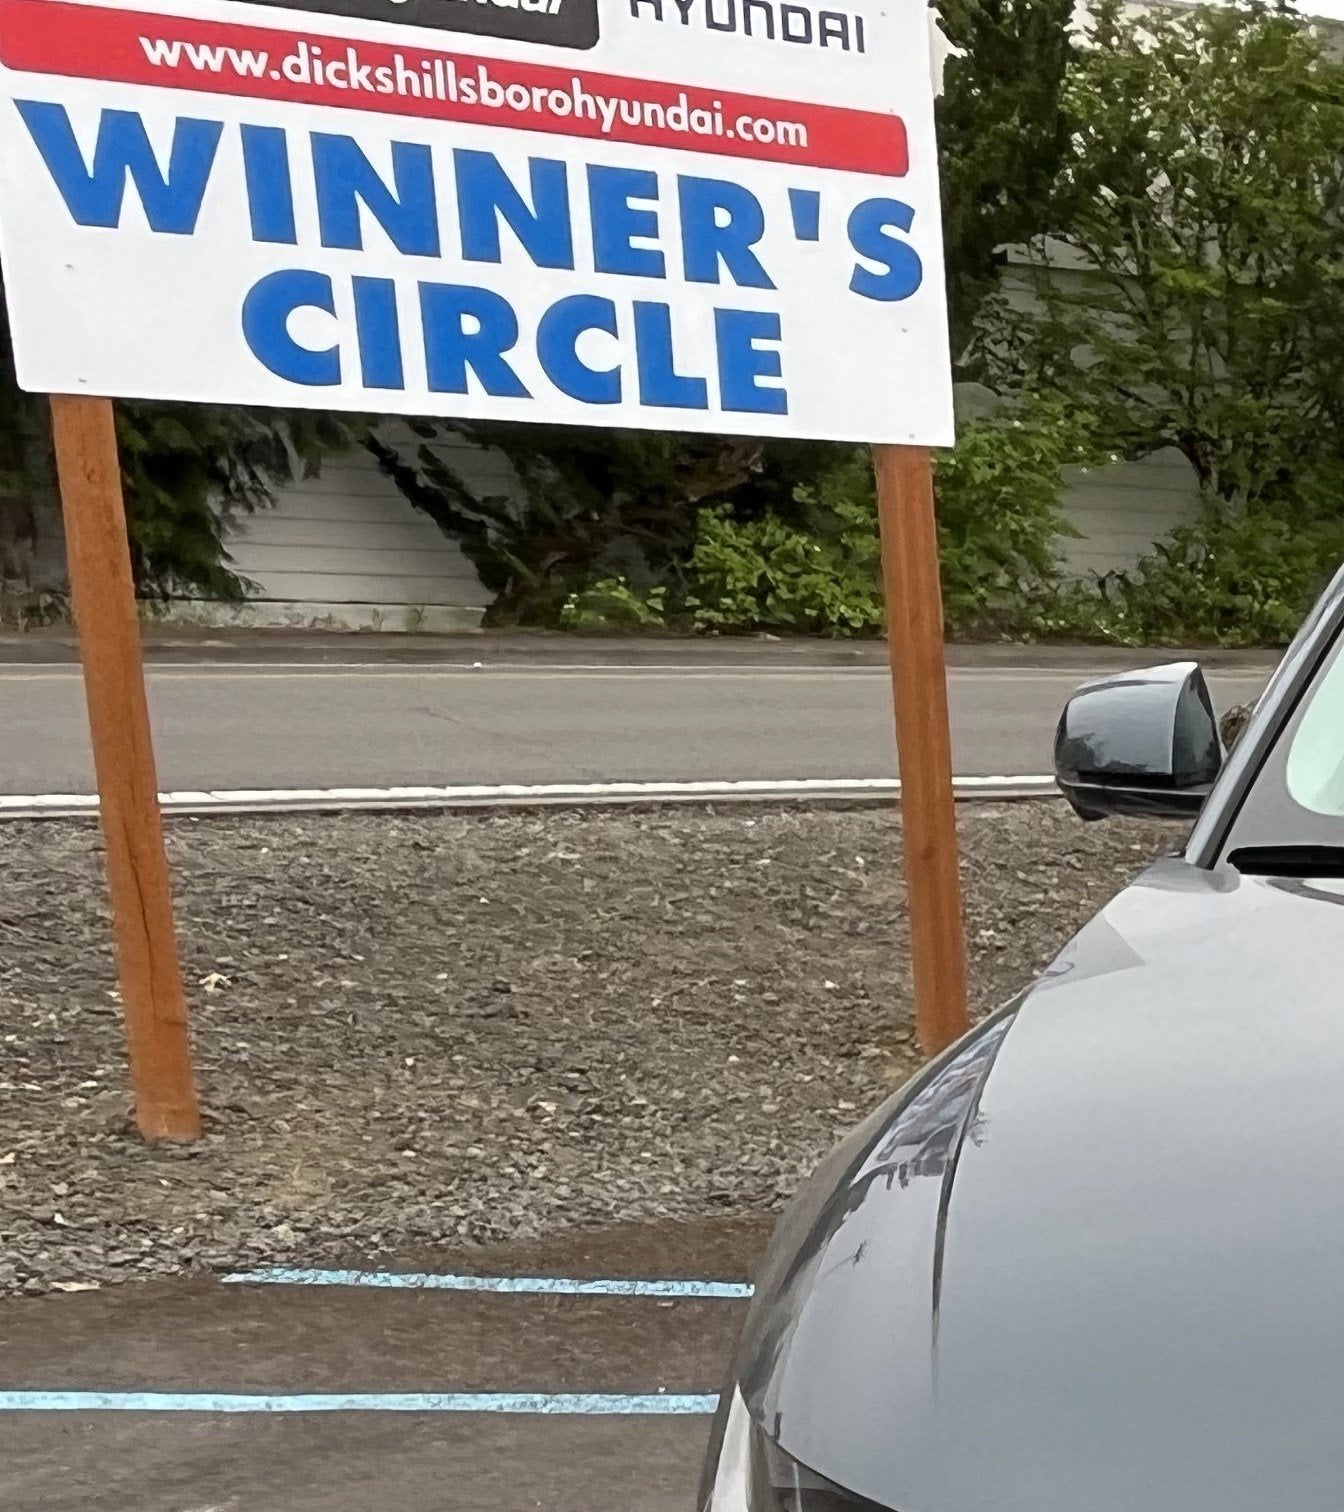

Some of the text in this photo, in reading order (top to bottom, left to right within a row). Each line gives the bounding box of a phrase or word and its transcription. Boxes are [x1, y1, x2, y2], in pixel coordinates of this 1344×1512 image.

[138, 35, 809, 149] www.dickshillsborohyundai.com
[12, 98, 924, 302] WINNER'S
[241, 268, 789, 416] CIRCLE
